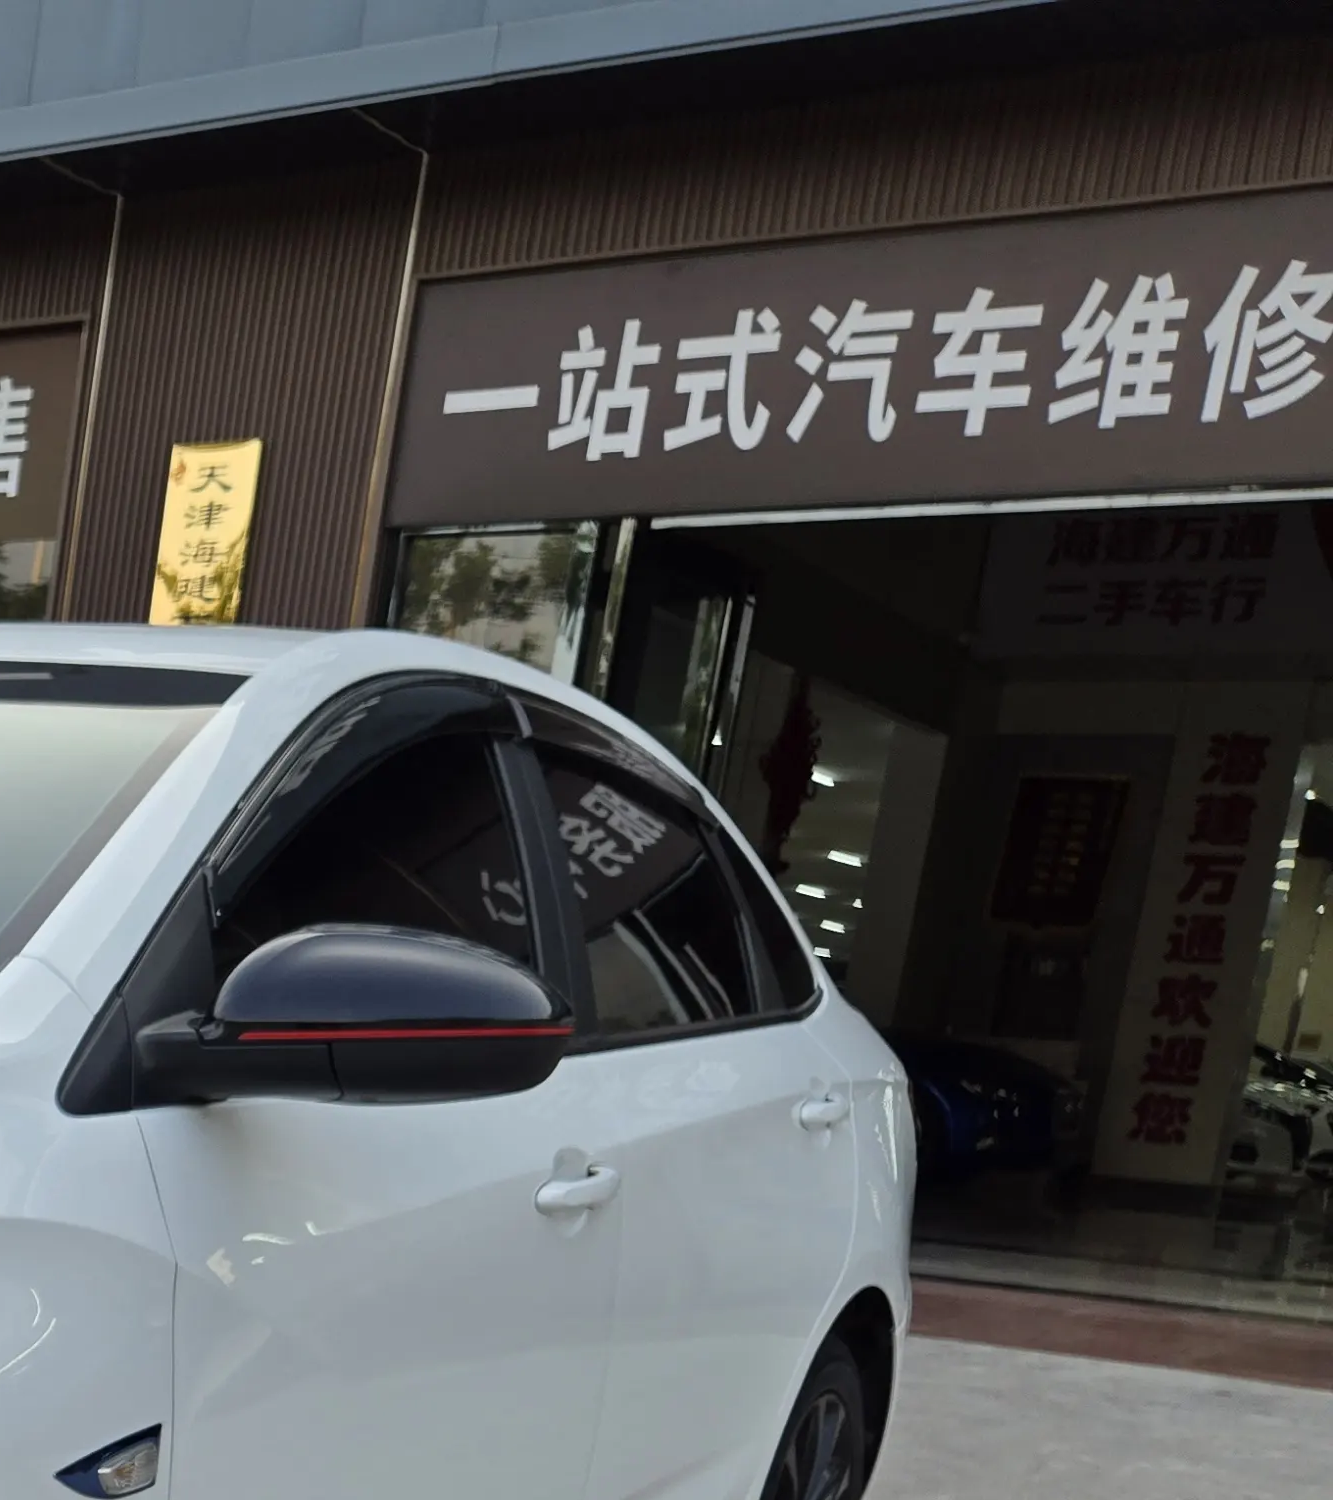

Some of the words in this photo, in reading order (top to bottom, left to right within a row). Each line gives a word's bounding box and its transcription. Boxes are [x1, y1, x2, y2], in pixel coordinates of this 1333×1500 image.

[442, 259, 1333, 463] 一站式汽车维修
[171, 463, 234, 626] 天津海建
[1048, 511, 1282, 569] 海建万通
[1037, 577, 1268, 626] 二手车行
